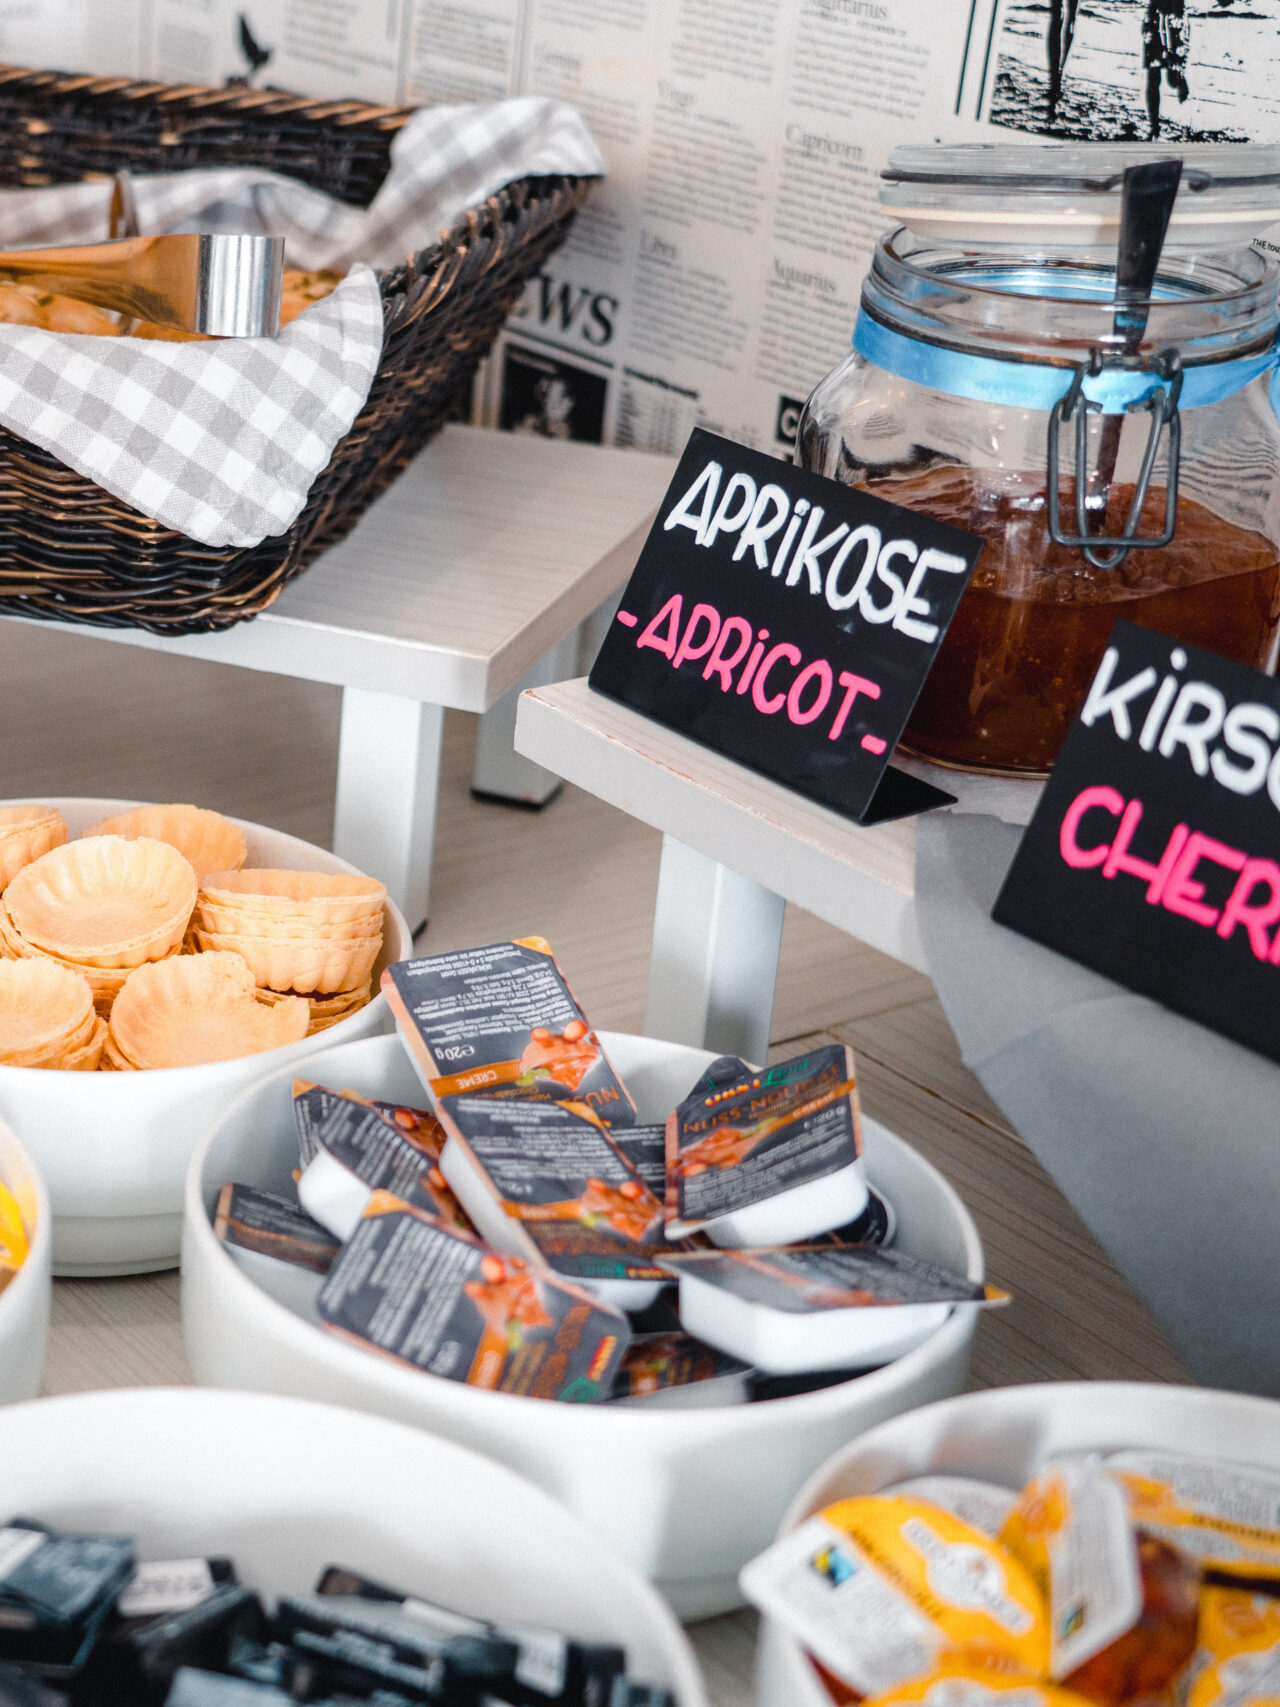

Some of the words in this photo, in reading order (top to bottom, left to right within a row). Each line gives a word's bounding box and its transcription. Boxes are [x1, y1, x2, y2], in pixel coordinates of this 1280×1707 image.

[785, 121, 863, 160] Capricorn
[1058, 784, 1280, 966] CHER
[455, 1069, 497, 1089] CREME
